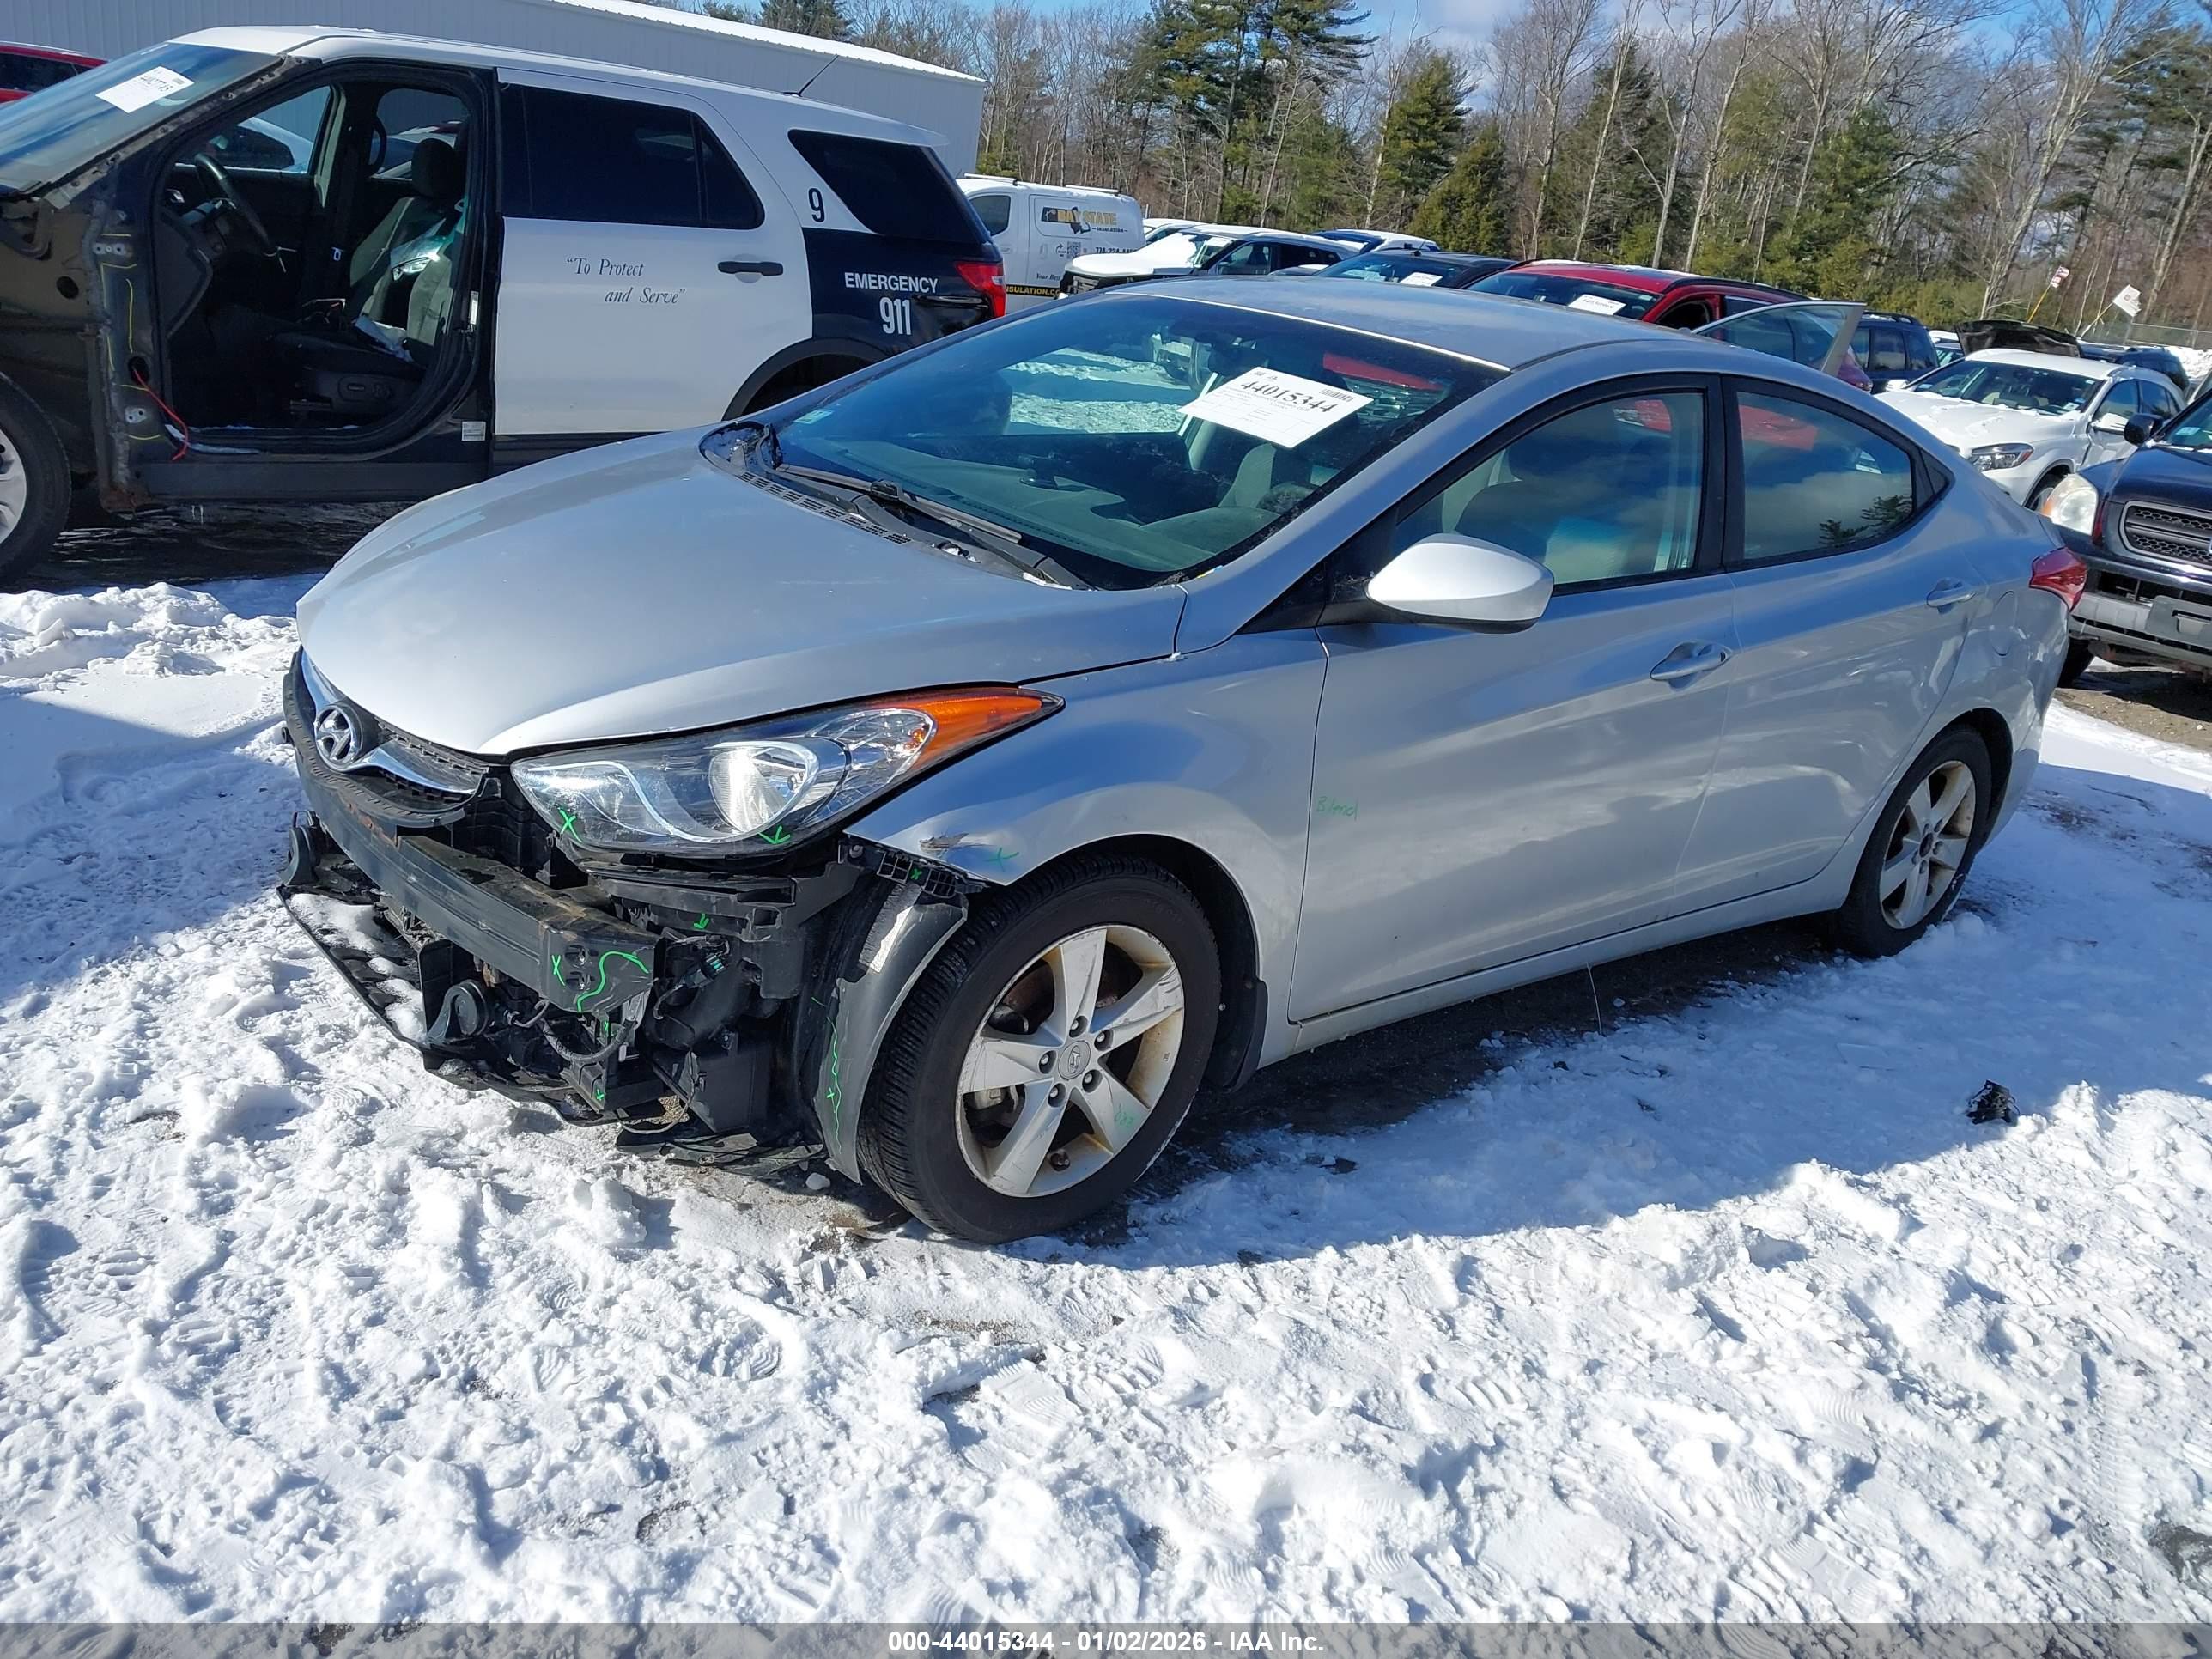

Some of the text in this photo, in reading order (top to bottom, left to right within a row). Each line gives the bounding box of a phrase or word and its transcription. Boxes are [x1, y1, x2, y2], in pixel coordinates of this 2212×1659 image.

[808, 188, 825, 222] 9
[1057, 210, 1117, 225] BAY STATE
[599, 258, 644, 276] Protect
[844, 272, 939, 293] EMERGENCY
[605, 287, 634, 302] and
[879, 297, 912, 335] 911
[1241, 380, 1338, 412] 44015344
